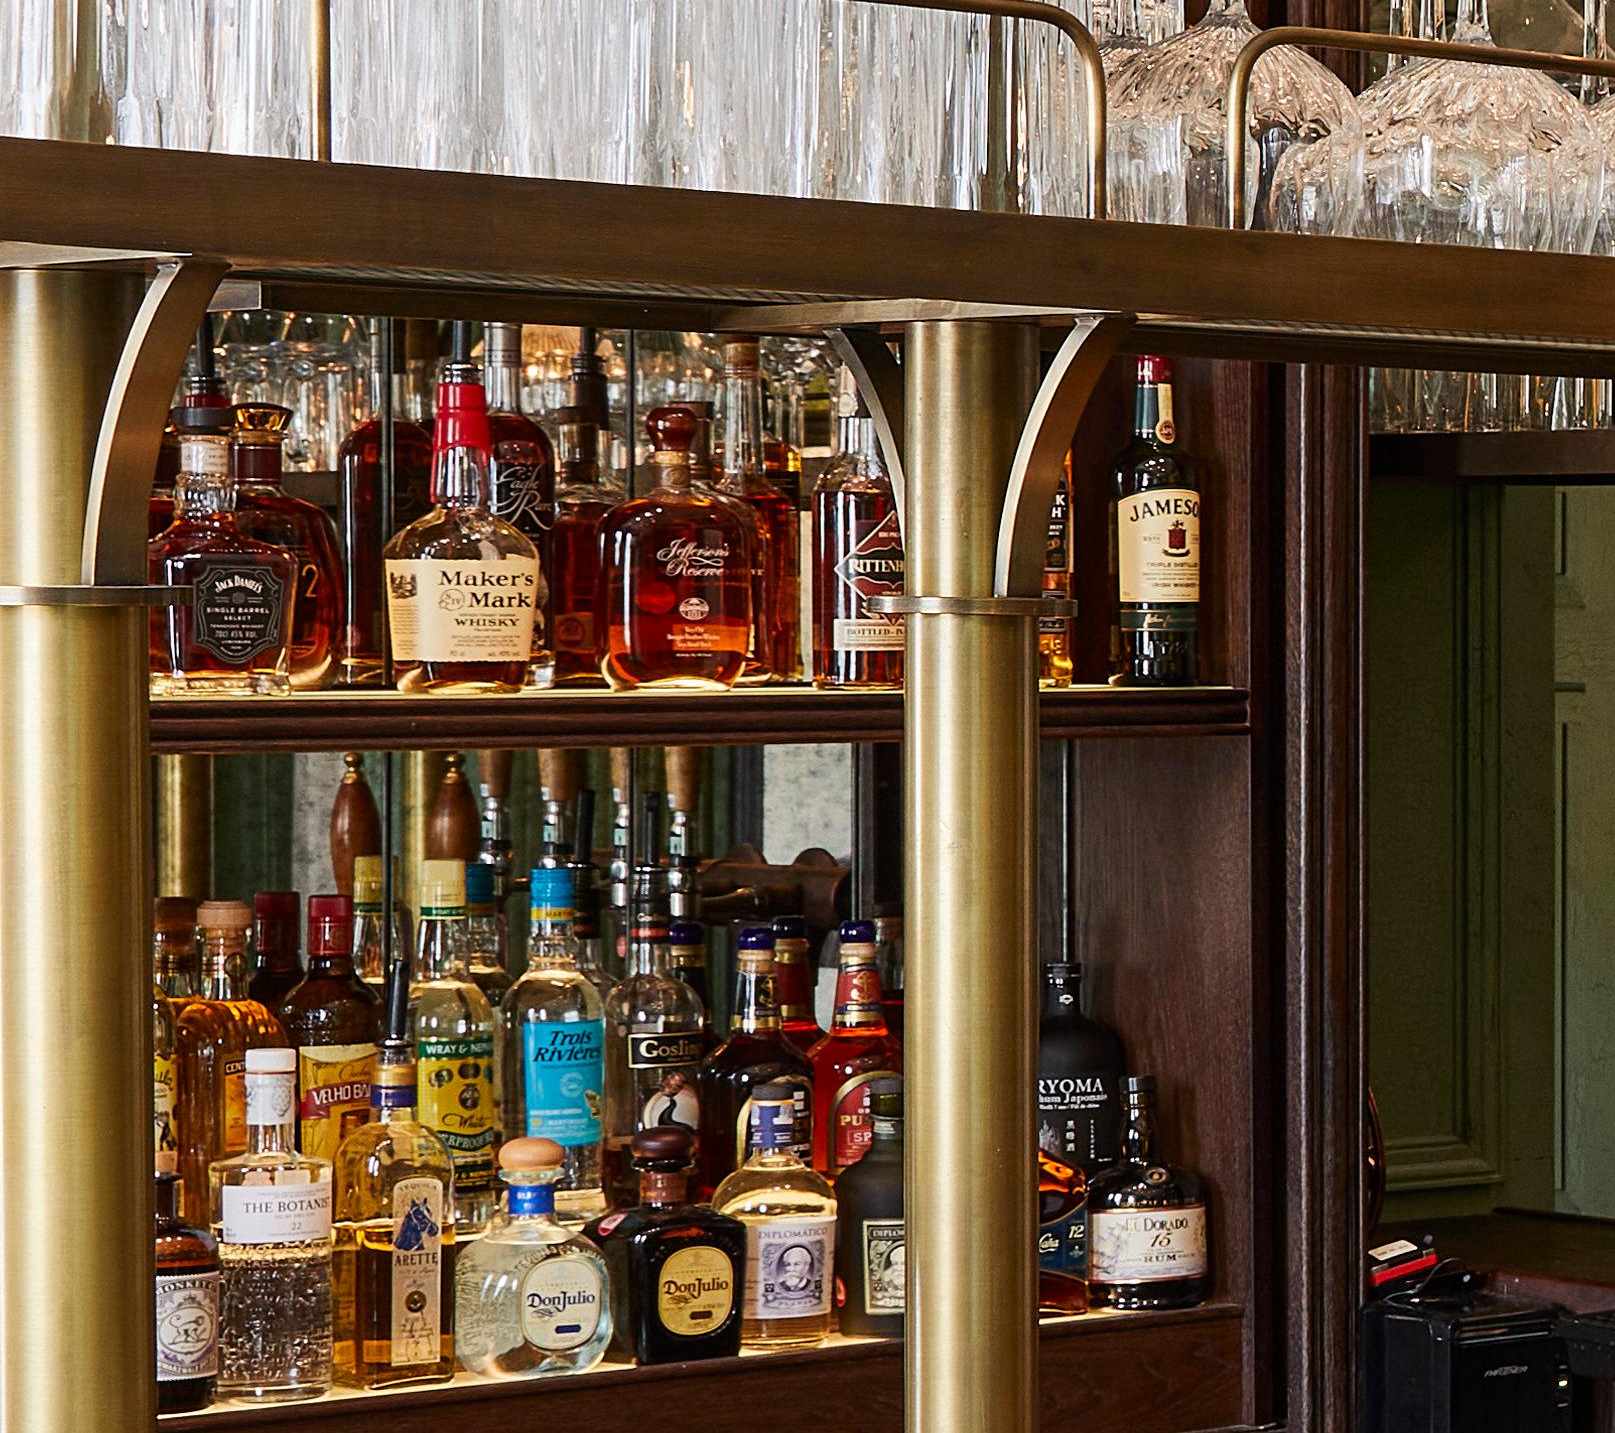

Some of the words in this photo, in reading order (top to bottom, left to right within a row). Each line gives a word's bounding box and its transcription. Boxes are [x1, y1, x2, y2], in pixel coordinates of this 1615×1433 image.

[215, 578, 233, 593] JACK
[234, 575, 263, 594] DANIEL'S
[438, 570, 534, 587] Maker's
[468, 592, 532, 608] Mark
[454, 618, 520, 627] WHISKY
[550, 1029, 592, 1047] Trois
[426, 1044, 456, 1055] WRAY
[458, 1044, 468, 1054] &
[1039, 1078, 1103, 1094] RYOMA
[312, 1085, 351, 1105] VELHO
[243, 1202, 274, 1214] THE
[278, 1196, 330, 1213] BOTANIST
[1068, 1224, 1085, 1239] 12
[1144, 1217, 1188, 1232] DORADO
[1151, 1232, 1173, 1248] 15
[394, 1252, 438, 1267] ARETTE
[1143, 1254, 1177, 1264] RUM
